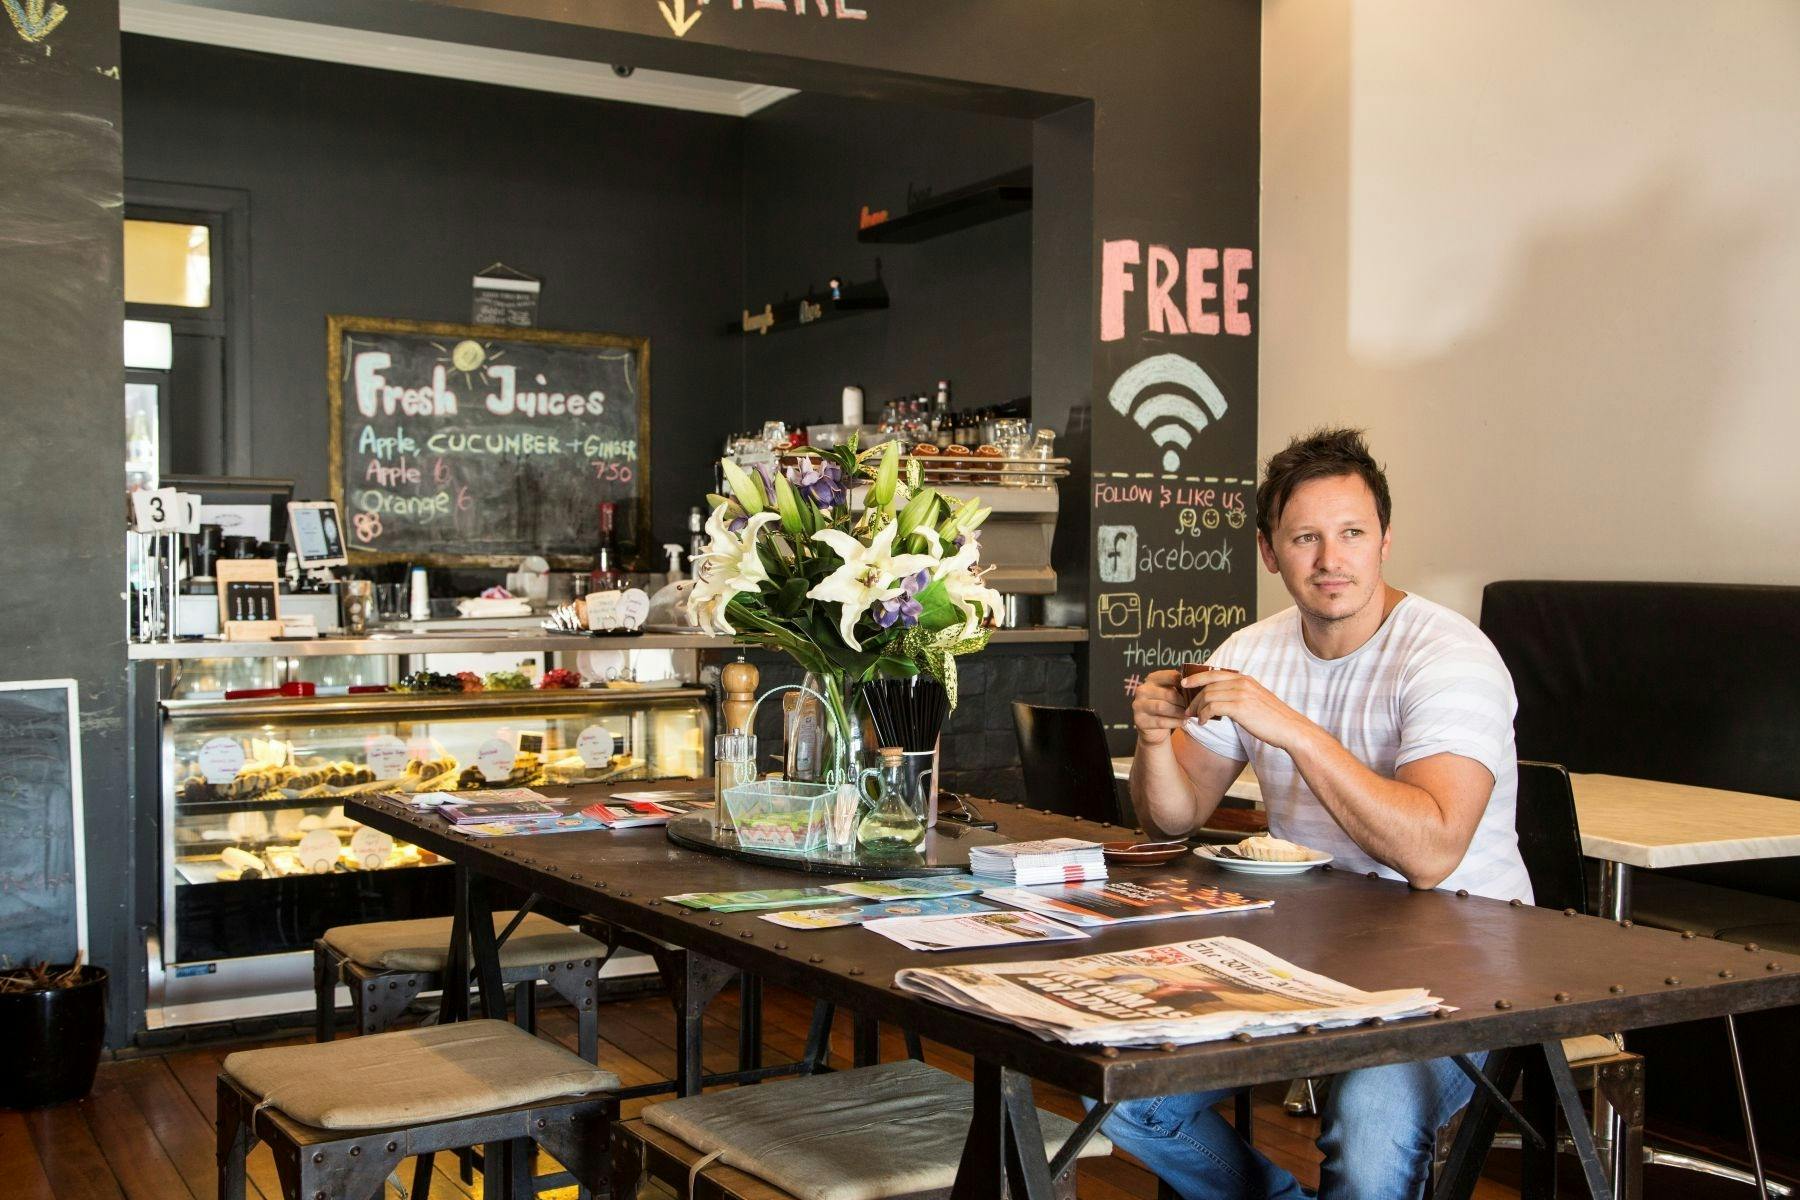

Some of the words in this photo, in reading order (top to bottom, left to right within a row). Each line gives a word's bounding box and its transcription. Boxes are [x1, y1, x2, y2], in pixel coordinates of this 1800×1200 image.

[1100, 239, 1252, 341] FREE
[354, 352, 457, 417] Fresh
[486, 365, 605, 418] Juices
[427, 433, 561, 454] CUCUMBER
[365, 456, 421, 487] Apple
[150, 496, 165, 523] 3
[361, 489, 449, 524] Orange
[1094, 483, 1152, 508] FOLLOW
[1147, 598, 1246, 646] Instagram
[1051, 990, 1151, 1019] ADULT
